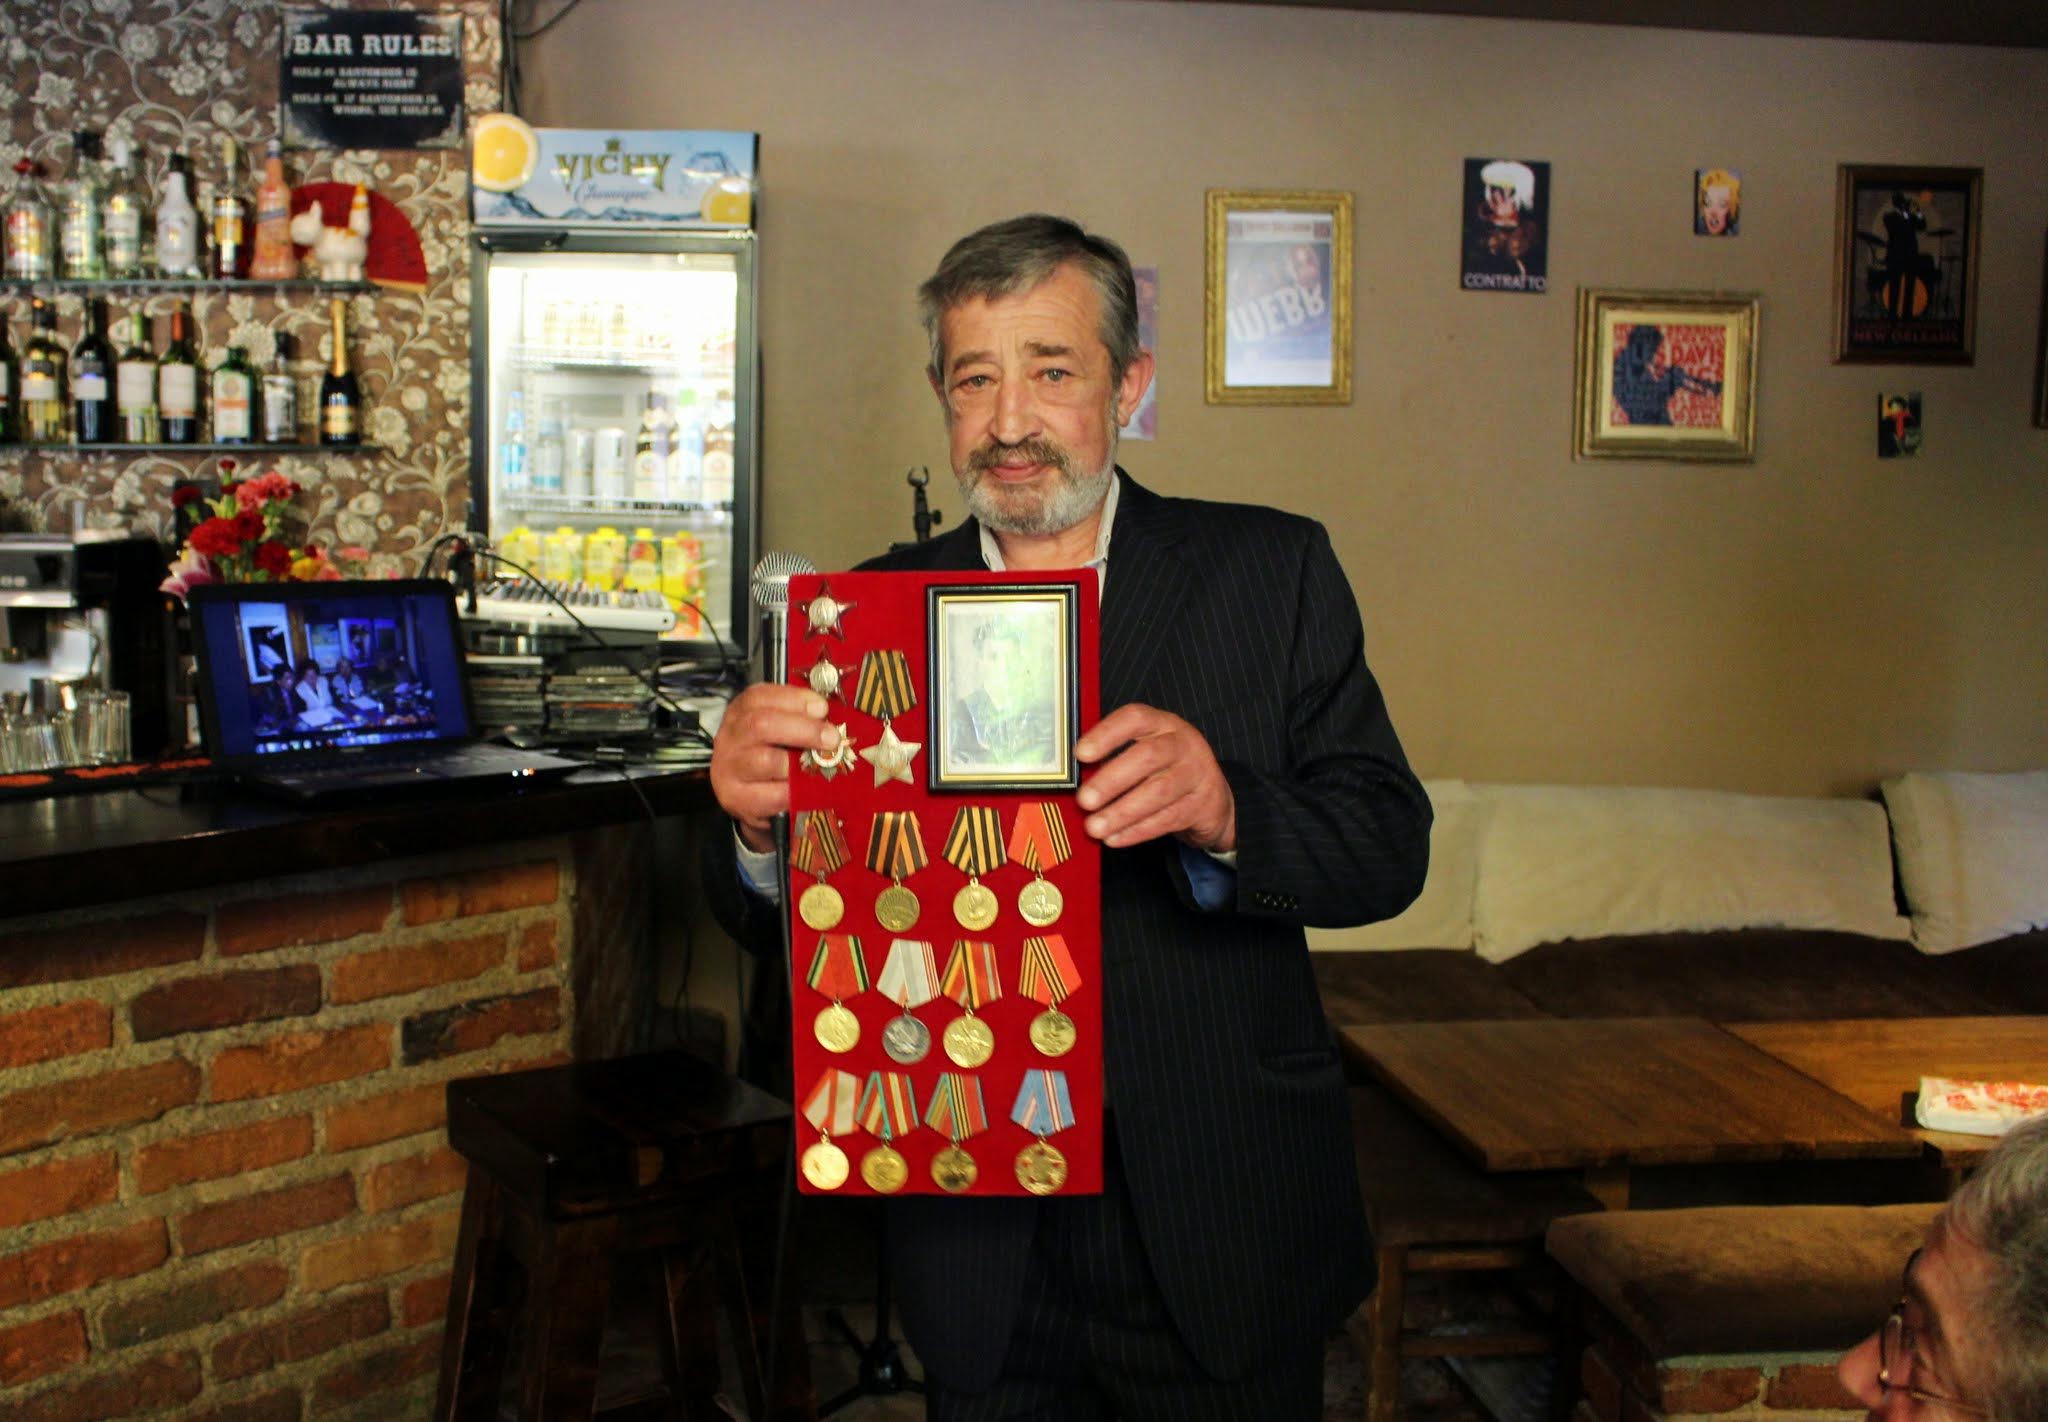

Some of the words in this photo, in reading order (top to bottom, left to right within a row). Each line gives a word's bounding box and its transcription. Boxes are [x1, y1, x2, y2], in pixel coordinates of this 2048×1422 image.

[293, 34, 353, 56] BAR
[362, 34, 453, 56] RULES
[555, 151, 673, 192] VICHY
[1463, 271, 1547, 291] CONTRATTO
[1854, 329, 1887, 343] NEW
[1891, 329, 1958, 343] ORLEANS
